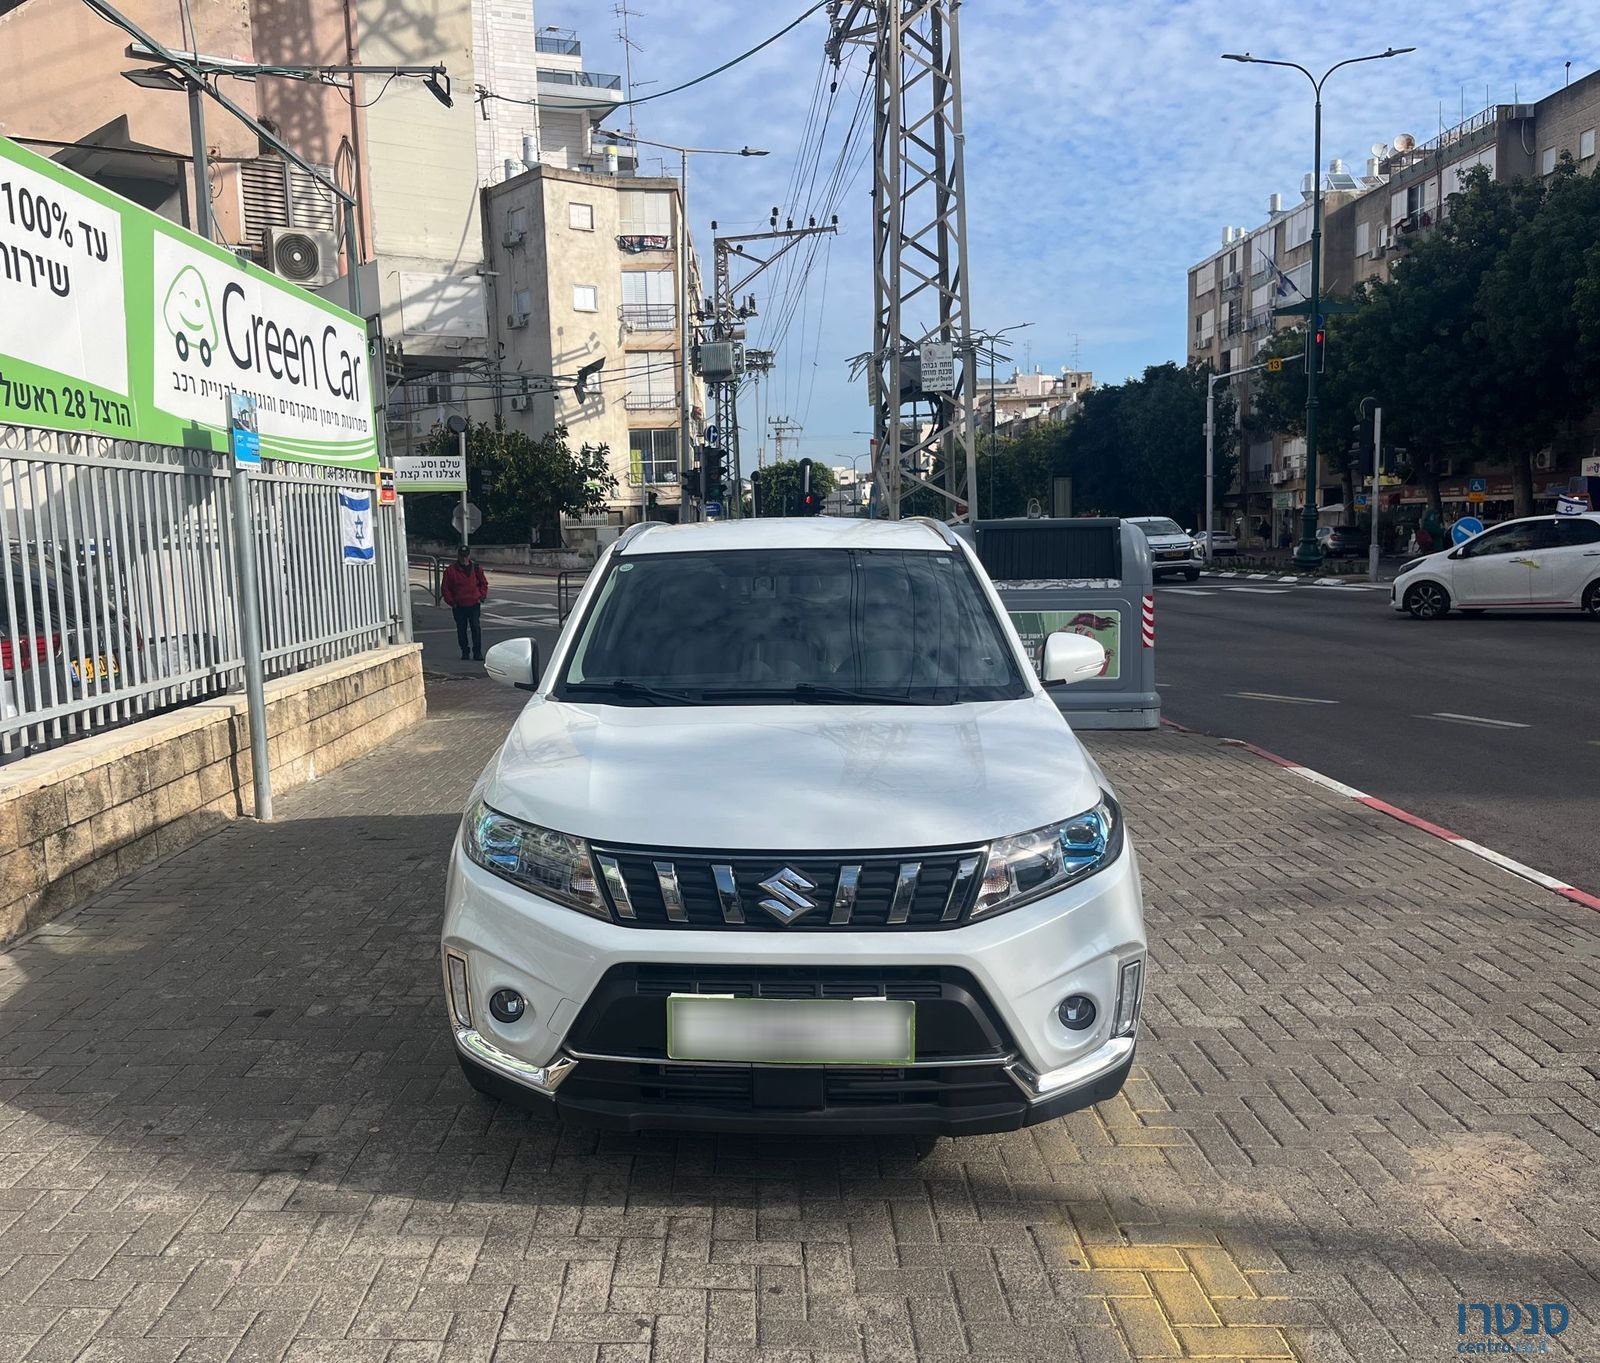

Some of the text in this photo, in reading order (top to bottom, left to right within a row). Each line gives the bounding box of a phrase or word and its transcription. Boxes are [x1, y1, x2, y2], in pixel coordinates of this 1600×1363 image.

[1, 182, 108, 262] עד 100%
[222, 282, 361, 402] Green Car
[1270, 360, 1280, 370] 13
[172, 371, 196, 394] רכב
[62, 386, 86, 419] 28
[89, 390, 131, 427] הרצל
[279, 398, 318, 423] מתקדמים
[320, 408, 340, 427] מימון
[341, 414, 368, 432] פתרונות
[440, 459, 460, 468] שלם
[400, 470, 420, 480] קצת
[423, 470, 433, 479] זה
[435, 469, 461, 479] אצלנו
